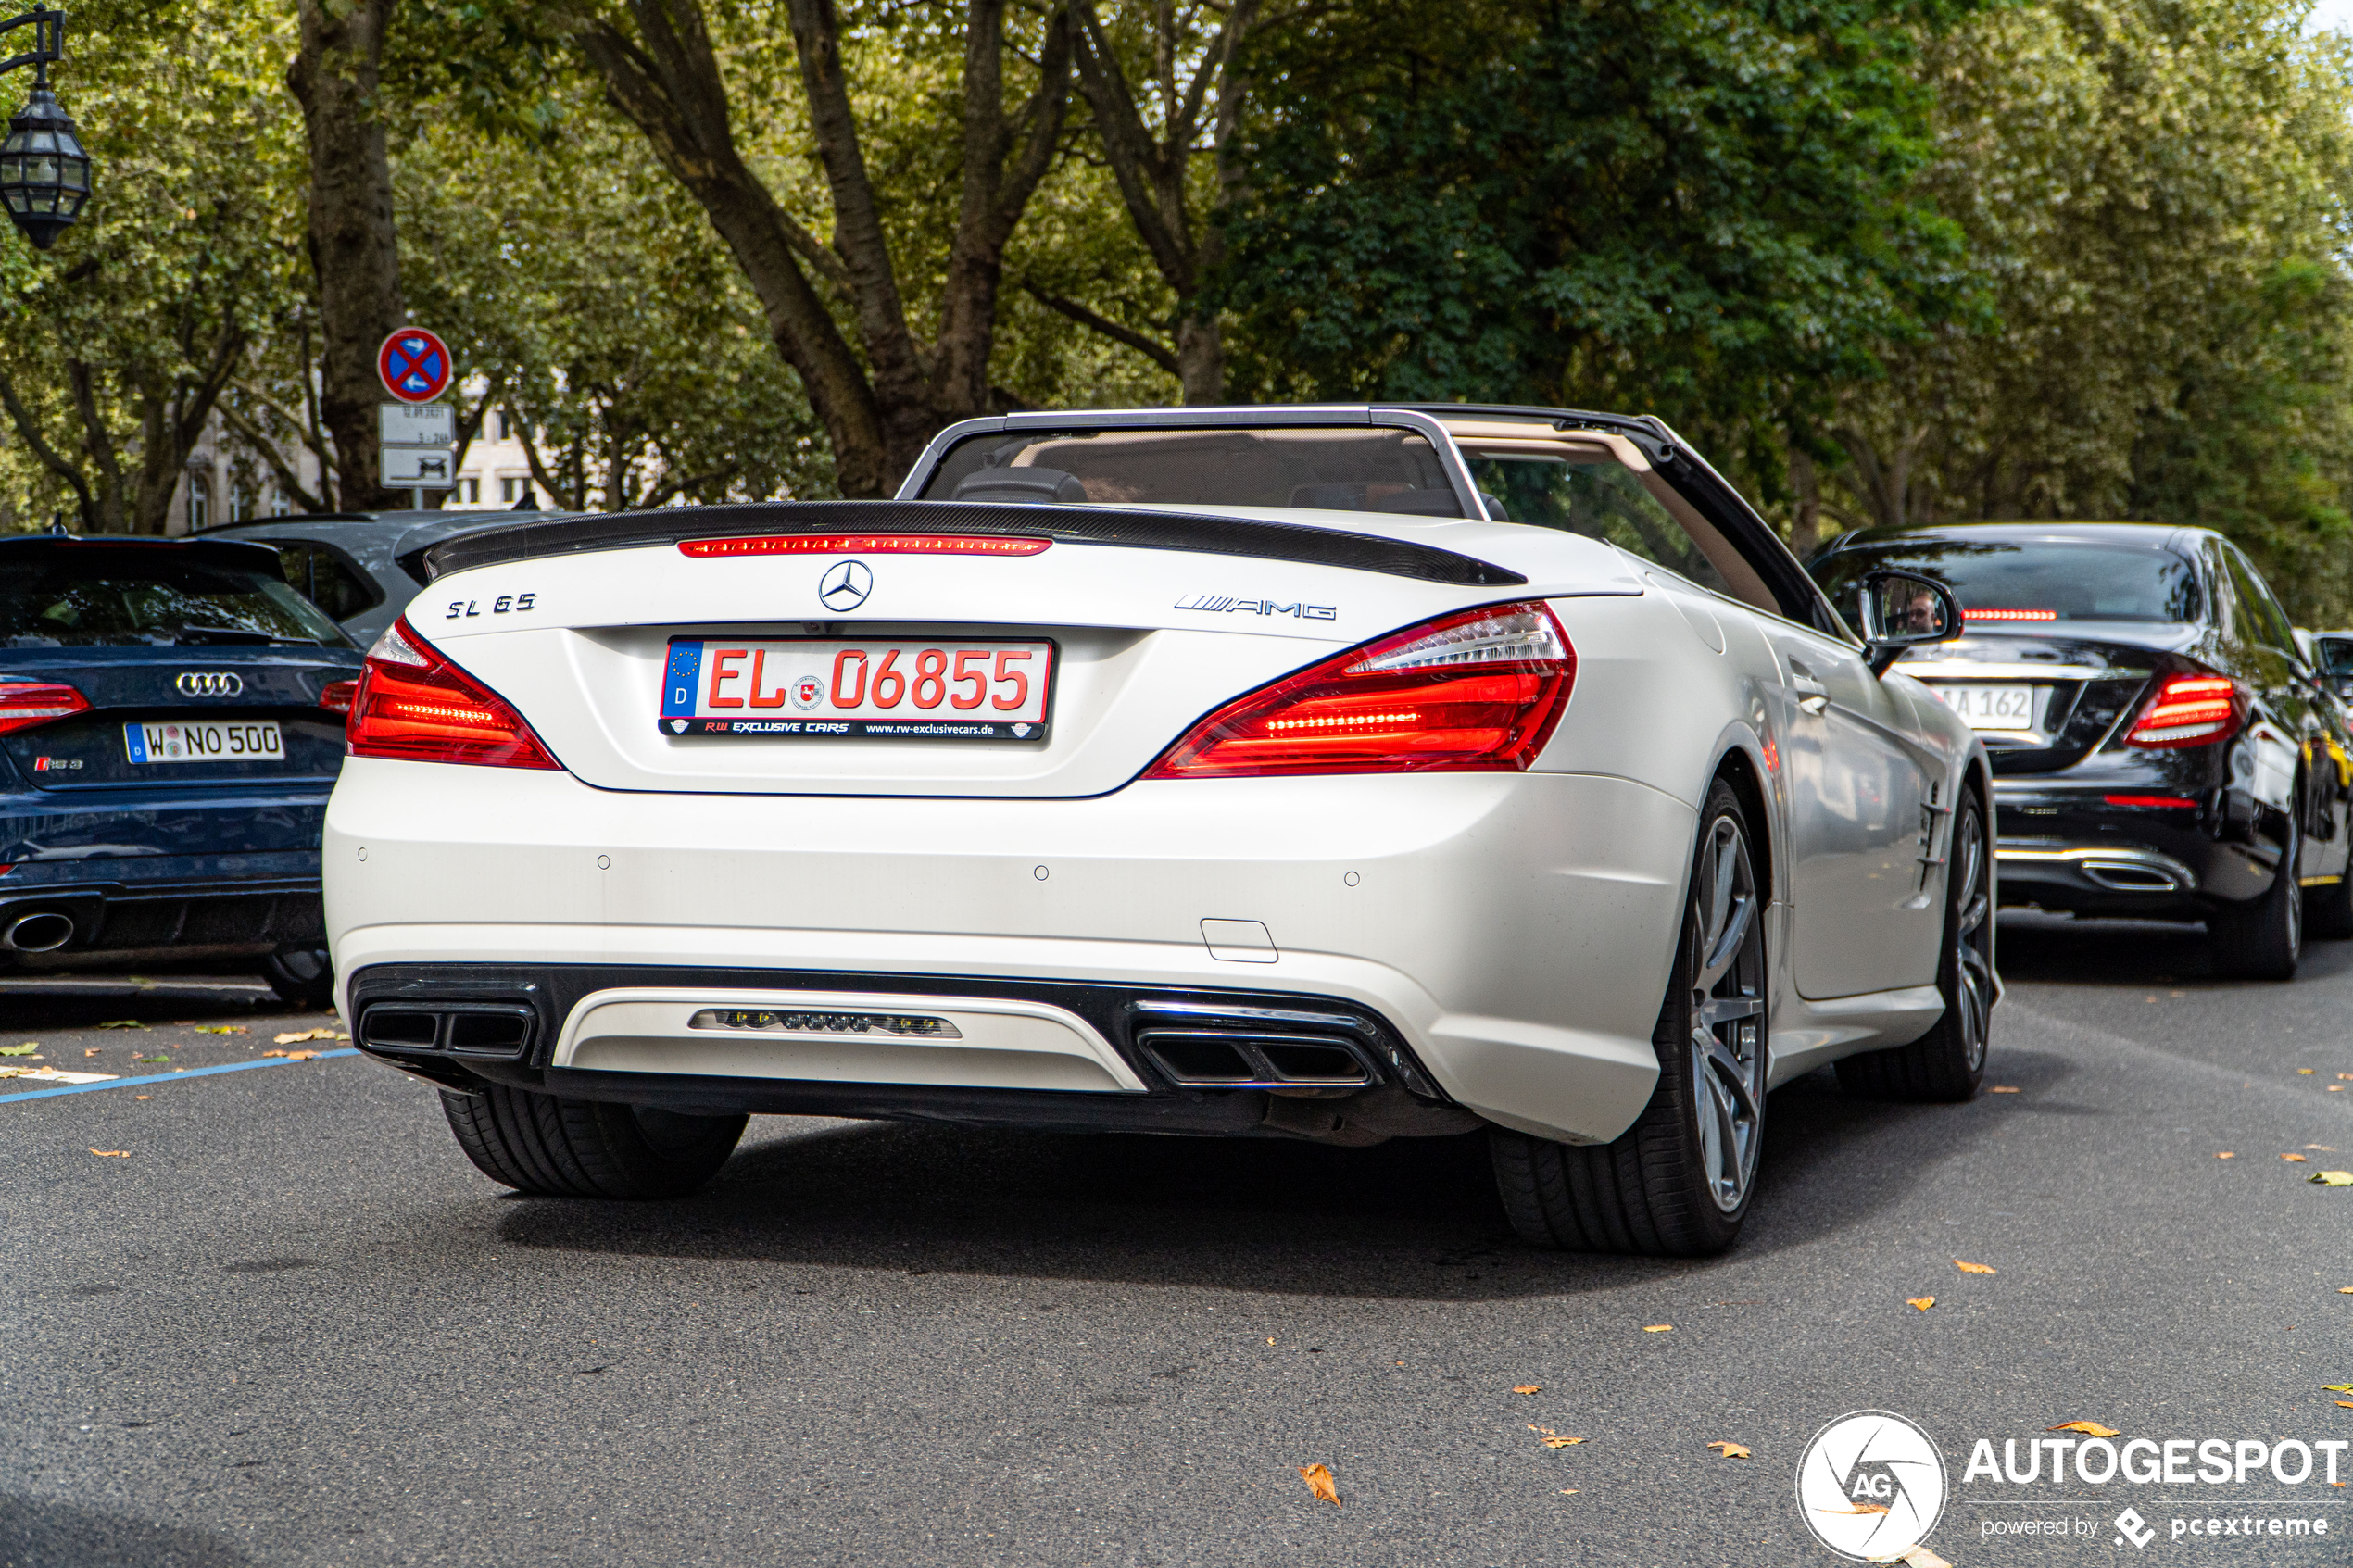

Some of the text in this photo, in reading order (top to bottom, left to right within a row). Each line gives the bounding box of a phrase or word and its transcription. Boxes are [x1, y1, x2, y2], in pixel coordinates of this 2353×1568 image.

[446, 593, 537, 620] SL 65
[708, 649, 1033, 711] EL 06855
[674, 687, 687, 705] D
[1979, 690, 2029, 718] 162
[146, 726, 279, 756] W NO 500
[732, 722, 802, 734] EXCLUSIVE
[805, 722, 850, 734] CARS
[865, 724, 995, 734] www.rw-exclusivecars.de
